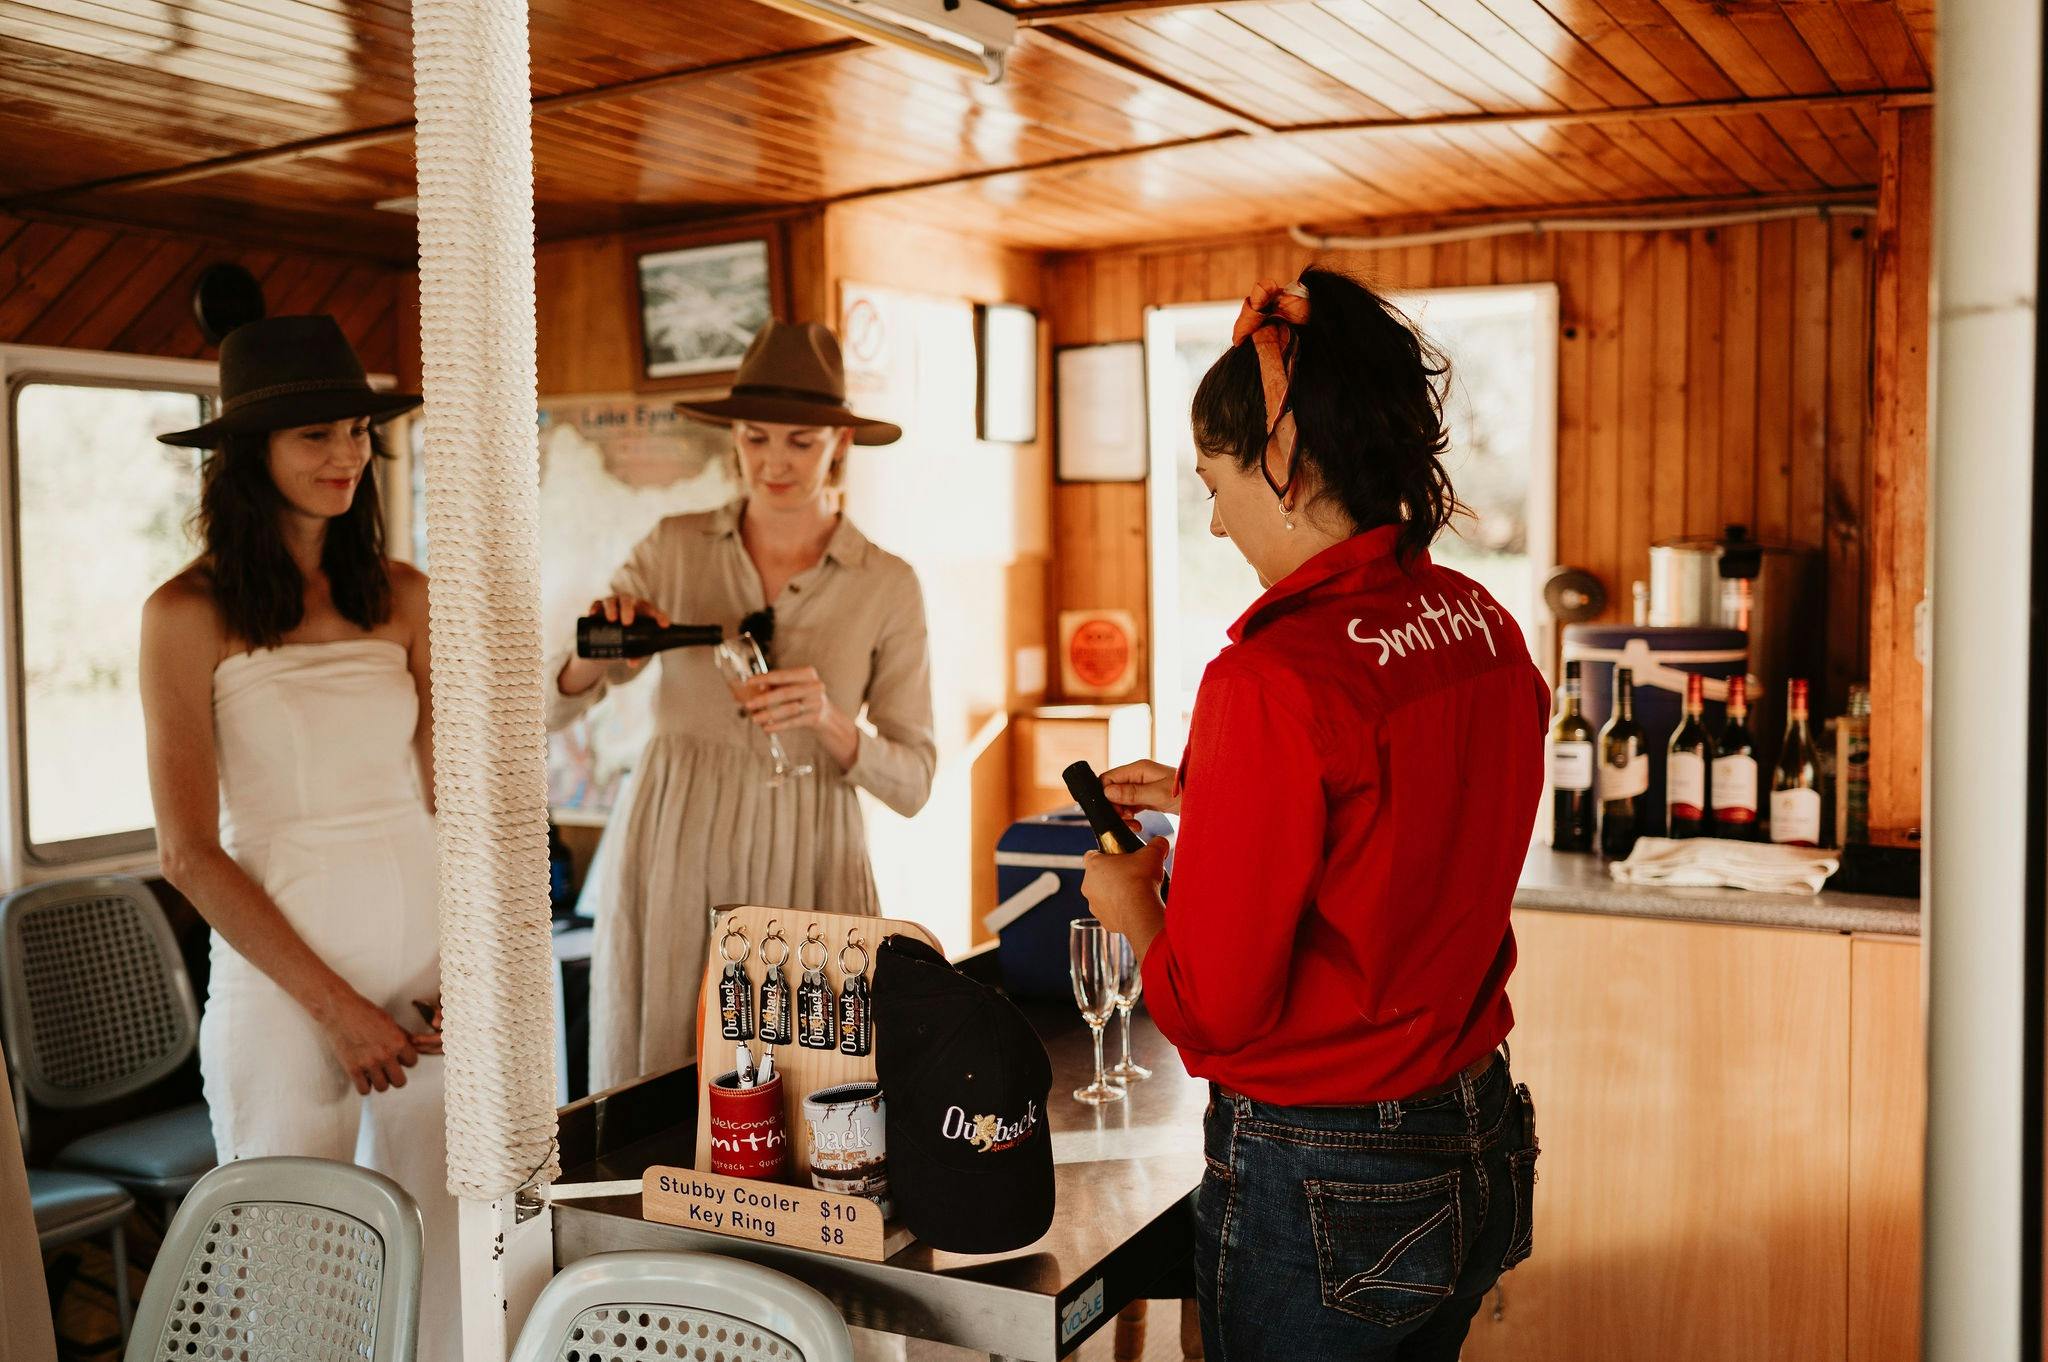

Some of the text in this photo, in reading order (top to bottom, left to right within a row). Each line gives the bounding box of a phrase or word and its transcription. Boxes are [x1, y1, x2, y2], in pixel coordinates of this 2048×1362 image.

[1347, 589, 1504, 666] Smithy's
[721, 980, 740, 1038] Ouback
[760, 983, 777, 1040] Ouback
[808, 989, 826, 1046] Ouback
[840, 994, 857, 1053] Ouback
[711, 1128, 787, 1152] mithy
[809, 1119, 872, 1151] back
[942, 1100, 1037, 1141] Ouback
[659, 1175, 857, 1222] Stubby Cooler $10
[689, 1204, 844, 1245] Key Ring $8
[1064, 1292, 1103, 1336] VOUE
